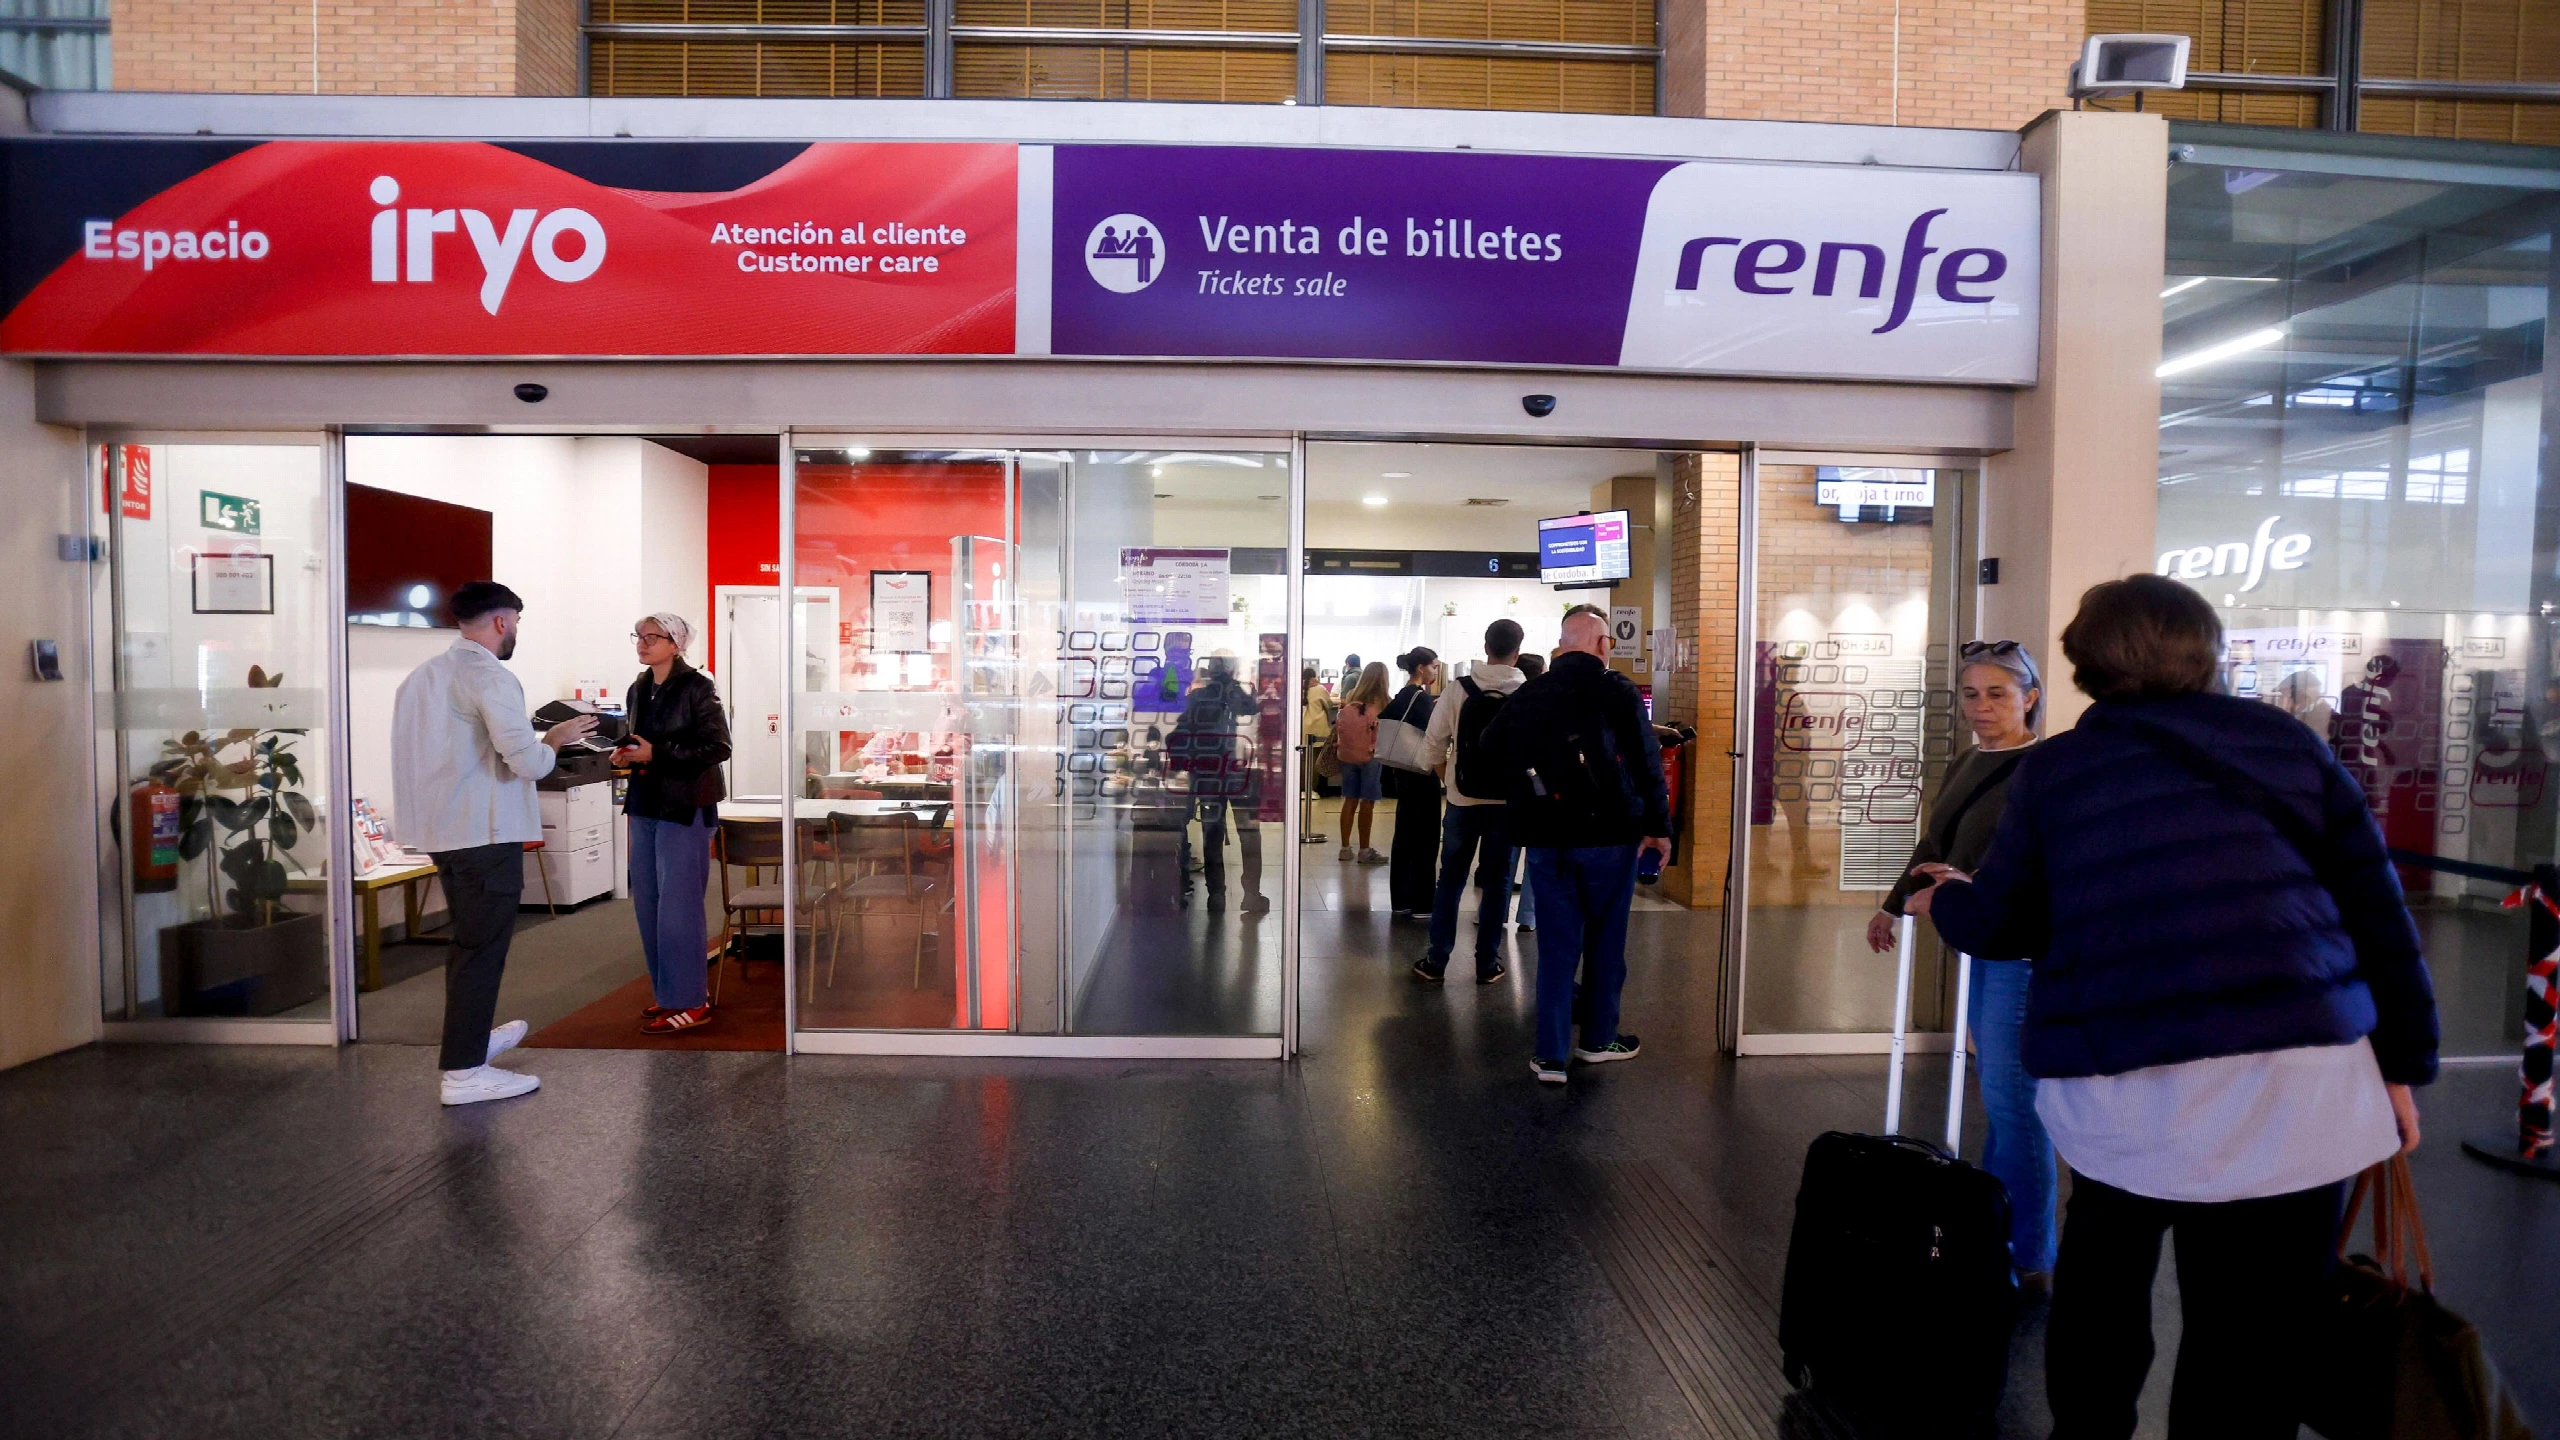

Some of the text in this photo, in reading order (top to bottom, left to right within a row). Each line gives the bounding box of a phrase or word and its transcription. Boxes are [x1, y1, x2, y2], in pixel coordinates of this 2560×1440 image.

[83, 220, 270, 272] Espacio
[371, 175, 607, 316] iryo
[710, 221, 967, 245] Atención al cliente
[1198, 215, 1563, 262] Venta de billetes
[737, 251, 939, 273] Customer care
[1675, 207, 2008, 334] renfe
[1197, 270, 1348, 297] Tickets sale
[122, 500, 147, 511] INTOR
[1854, 486, 1877, 504] oja
[1489, 558, 1499, 573] 6
[2156, 515, 2312, 592] renfe
[1616, 608, 1636, 617] renfe
[2267, 630, 2327, 657] renfe
[1789, 707, 1863, 737] renfe
[2361, 655, 2392, 766] renfe
[2476, 766, 2542, 793] renfe
